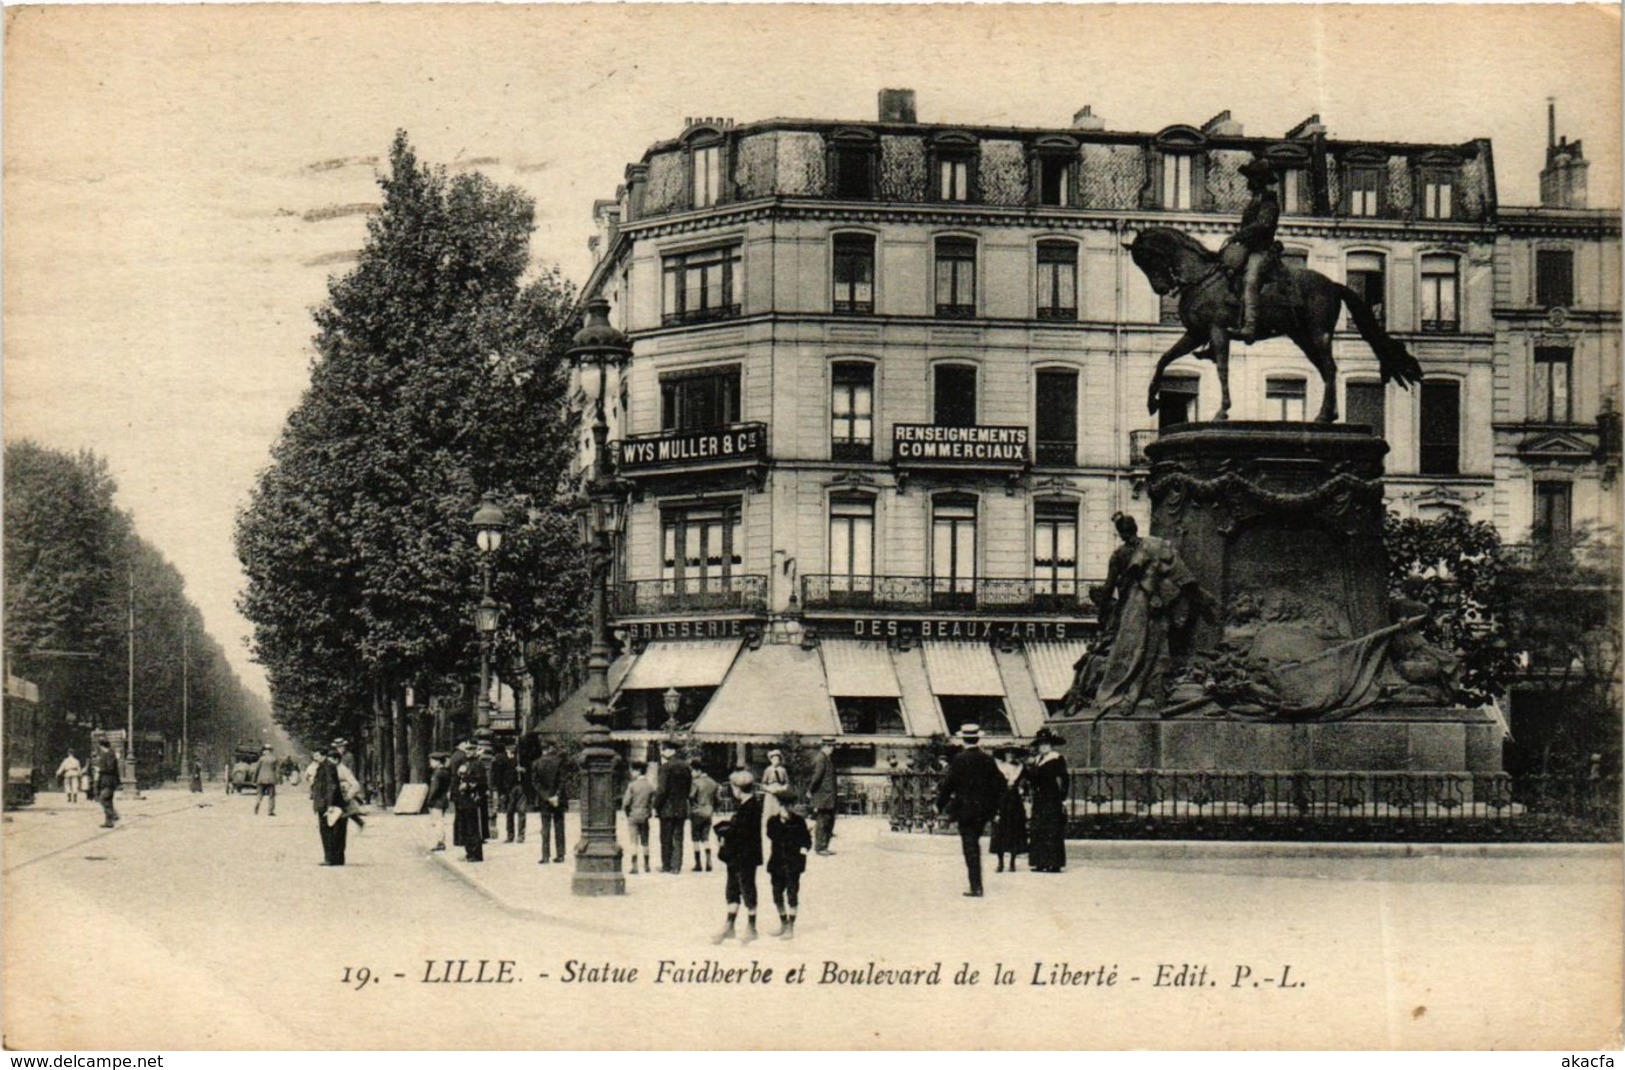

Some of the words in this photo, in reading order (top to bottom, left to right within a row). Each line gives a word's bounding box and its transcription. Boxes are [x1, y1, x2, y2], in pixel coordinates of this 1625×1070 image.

[895, 426, 1027, 443] RENSEIGNEMENTS
[623, 443, 655, 464] WYS
[658, 436, 718, 460] MULLER
[723, 434, 733, 453] &
[900, 442, 1023, 459] COMMERCIAUX
[854, 620, 898, 636] DES
